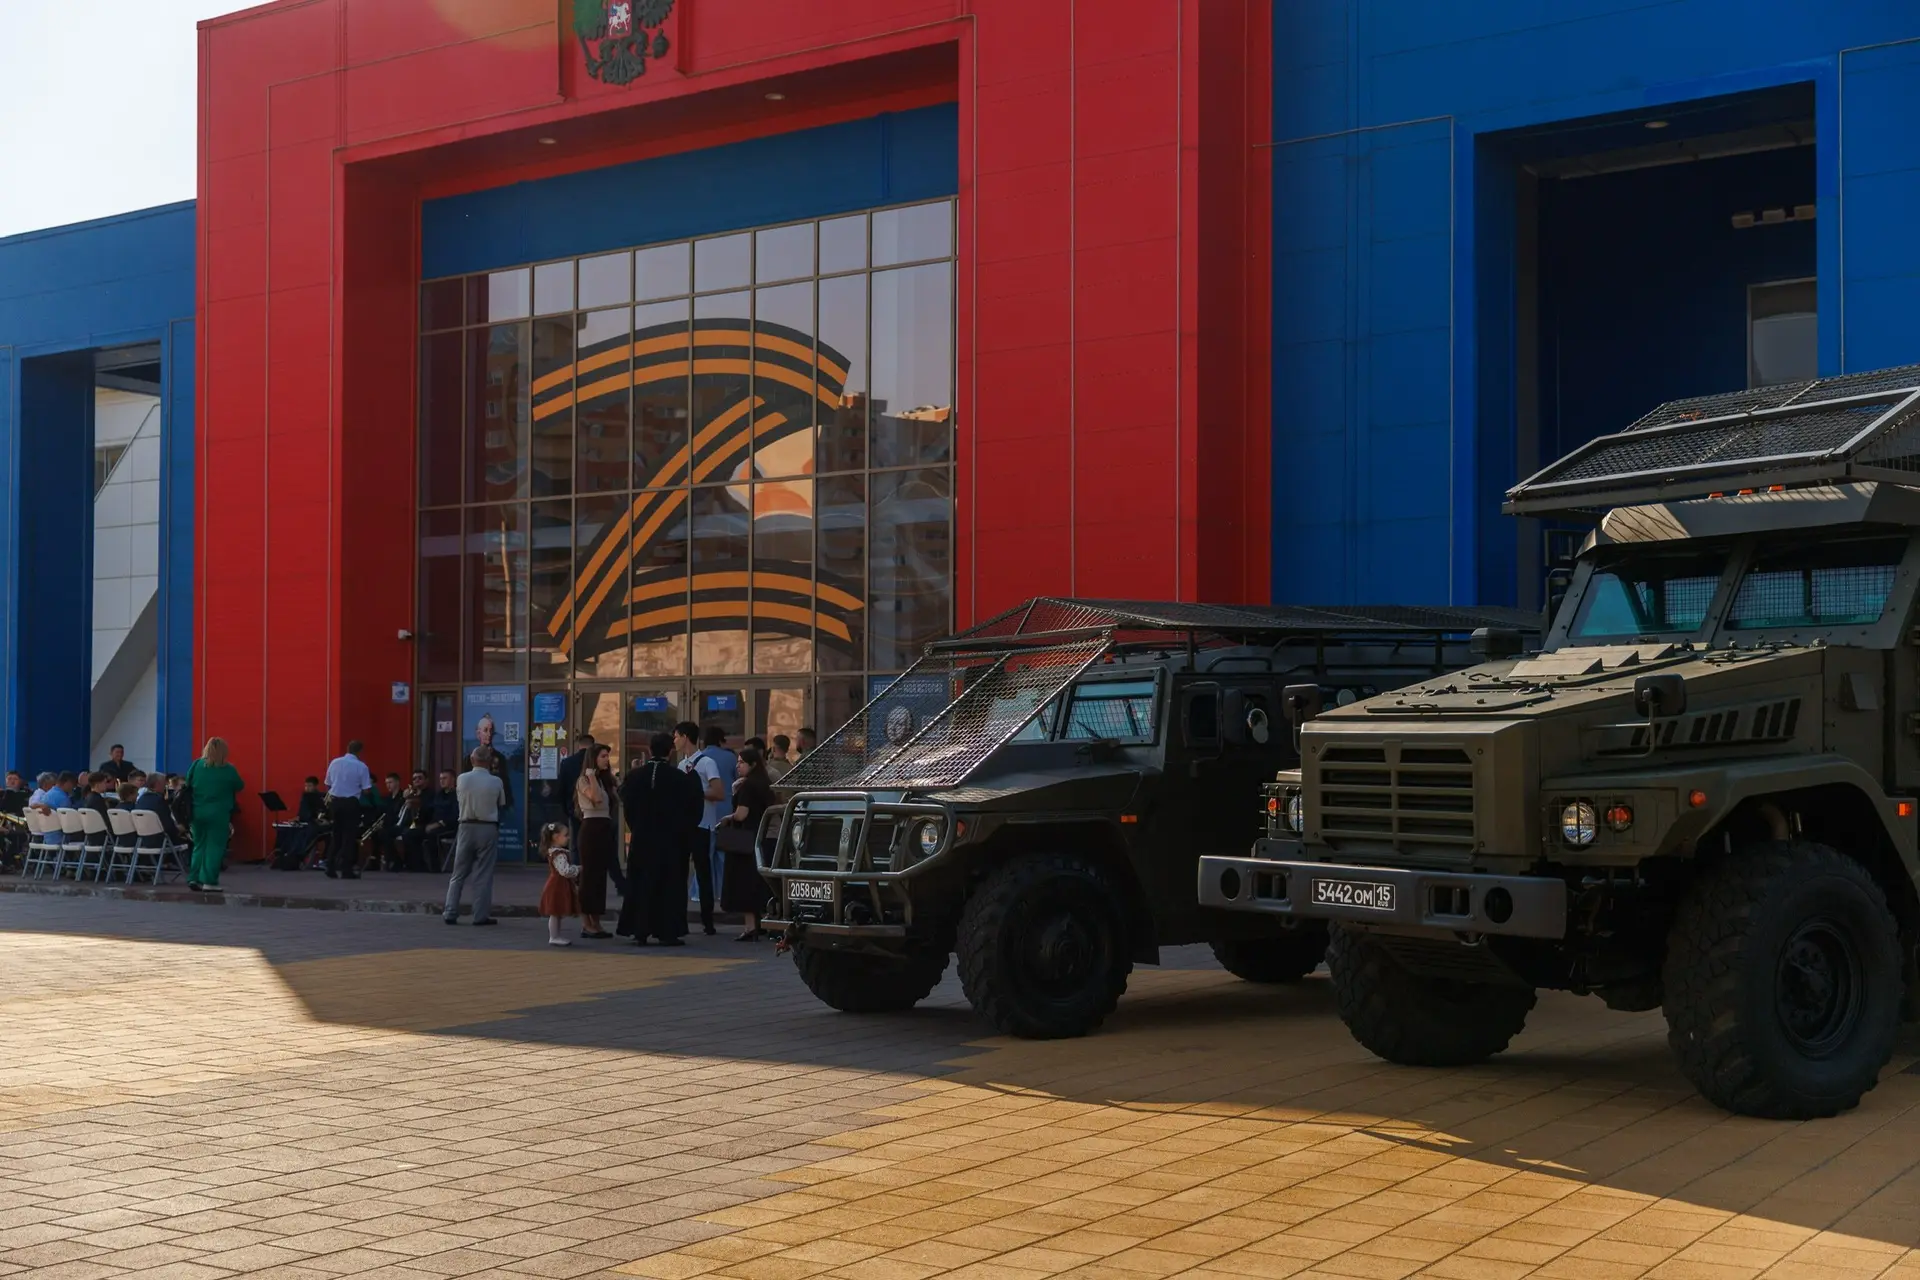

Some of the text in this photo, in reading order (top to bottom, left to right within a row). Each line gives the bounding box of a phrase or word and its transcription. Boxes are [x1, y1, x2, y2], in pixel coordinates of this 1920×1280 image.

[790, 882, 810, 898] 2058
[823, 883, 832, 895] 15
[1318, 882, 1352, 903] 5442
[1376, 886, 1391, 901] 15
